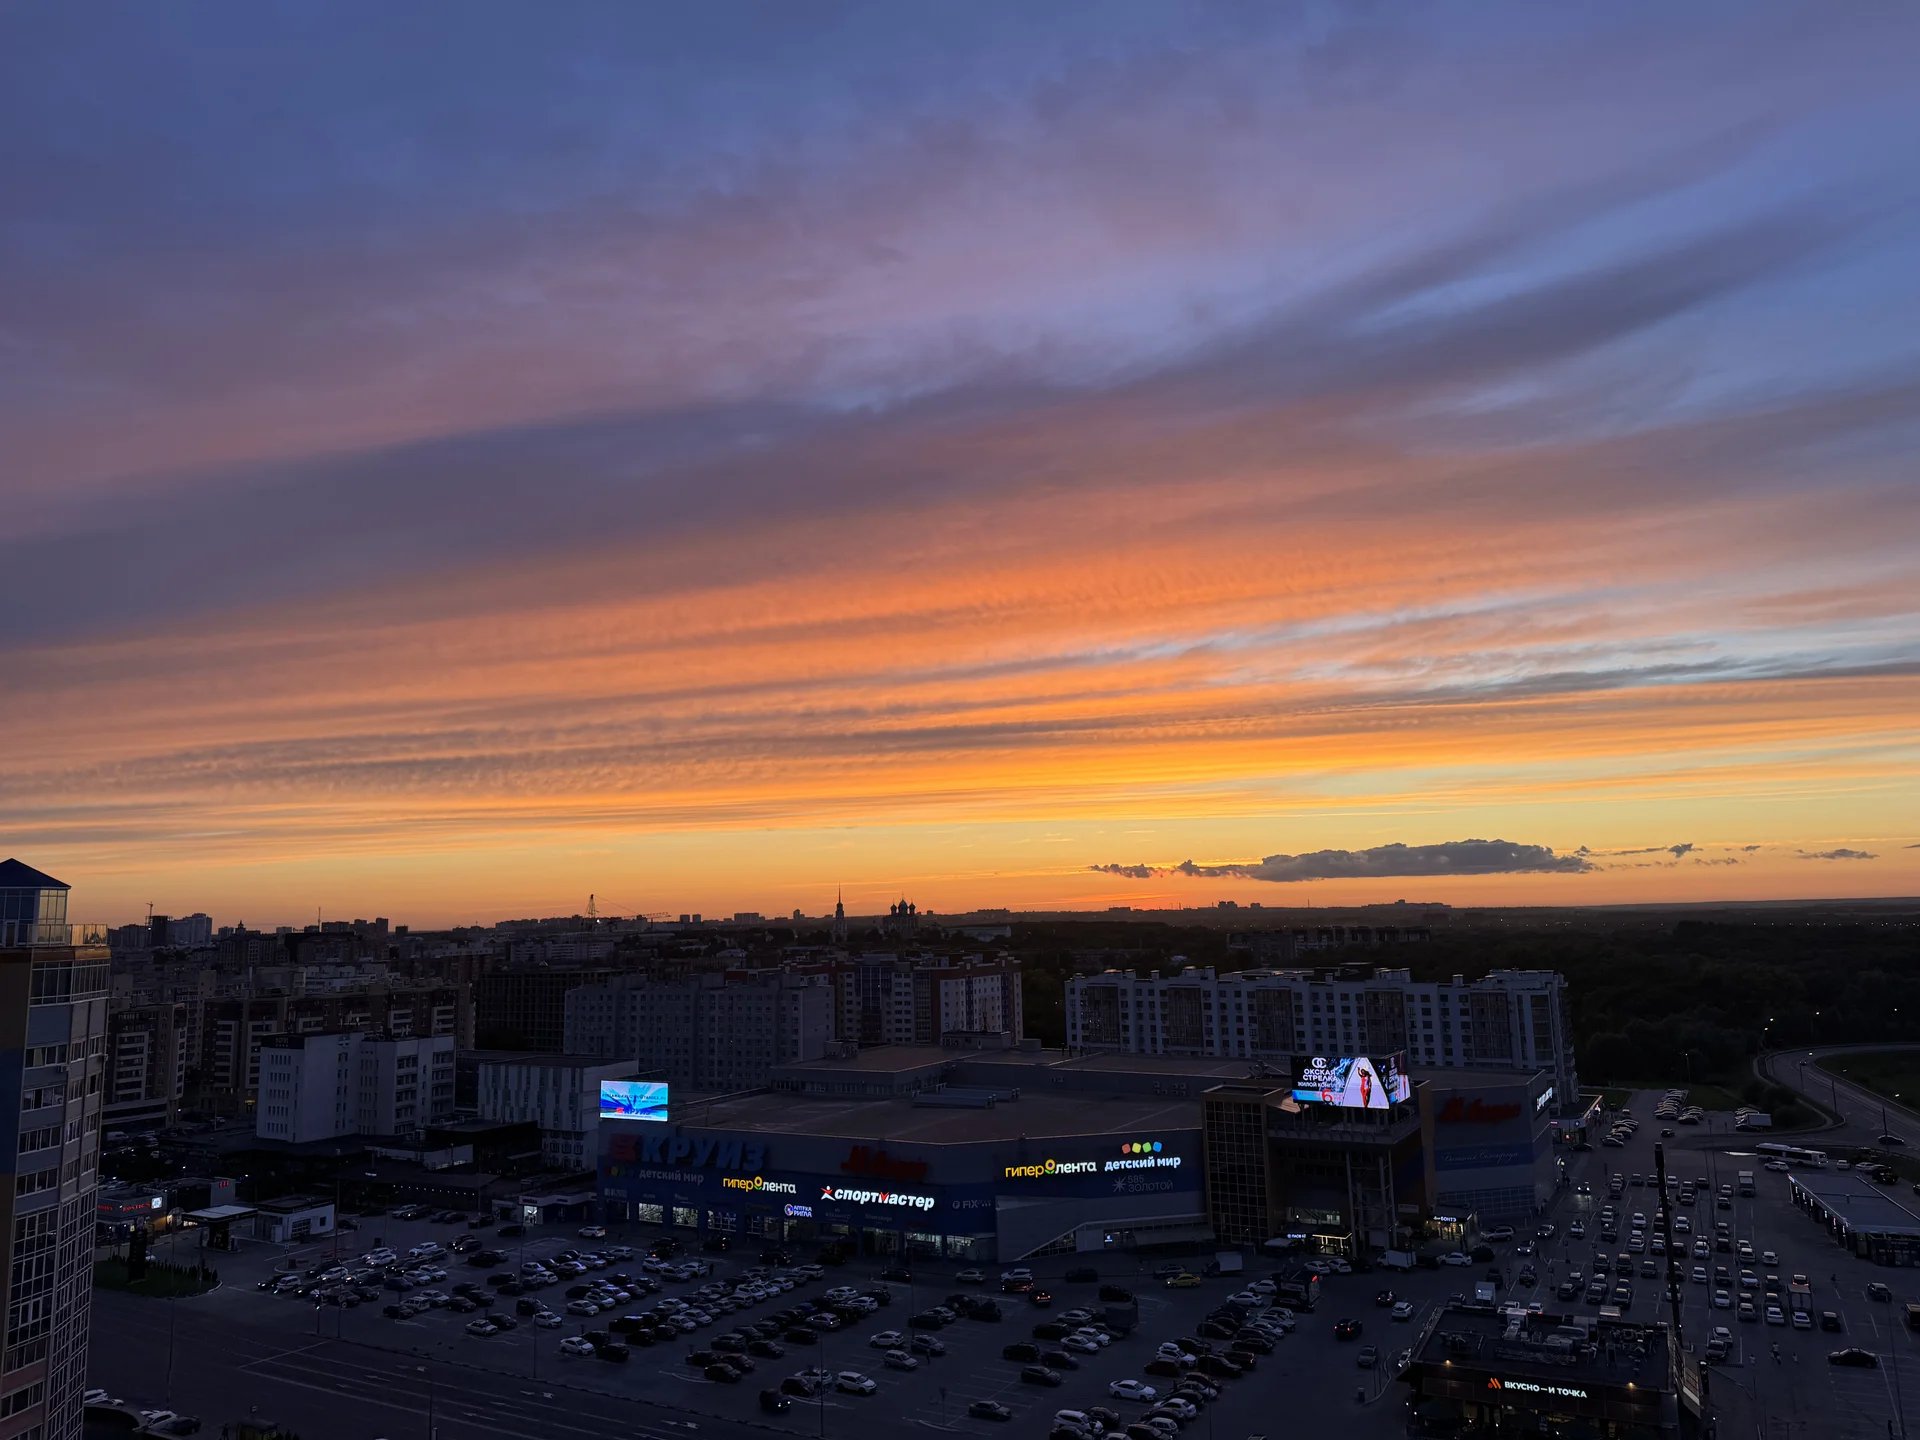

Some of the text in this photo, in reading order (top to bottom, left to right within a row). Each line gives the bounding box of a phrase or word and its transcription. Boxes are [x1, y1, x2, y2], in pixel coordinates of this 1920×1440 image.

[1302, 1074, 1338, 1082] СТРЕЛКА
[1303, 1068, 1336, 1076] ОКСКАЯ
[641, 1135, 769, 1172] КРУИЗ
[1104, 1156, 1181, 1172] детский мир
[639, 1169, 705, 1186] детский мир
[1127, 1175, 1145, 1184] 585
[1128, 1180, 1174, 1193] ЗОЛОТОЙ
[793, 1204, 812, 1212] АПТЕКА
[1504, 1381, 1540, 1392] ВКУСНО
[1557, 1387, 1588, 1398] ТОЧКА
